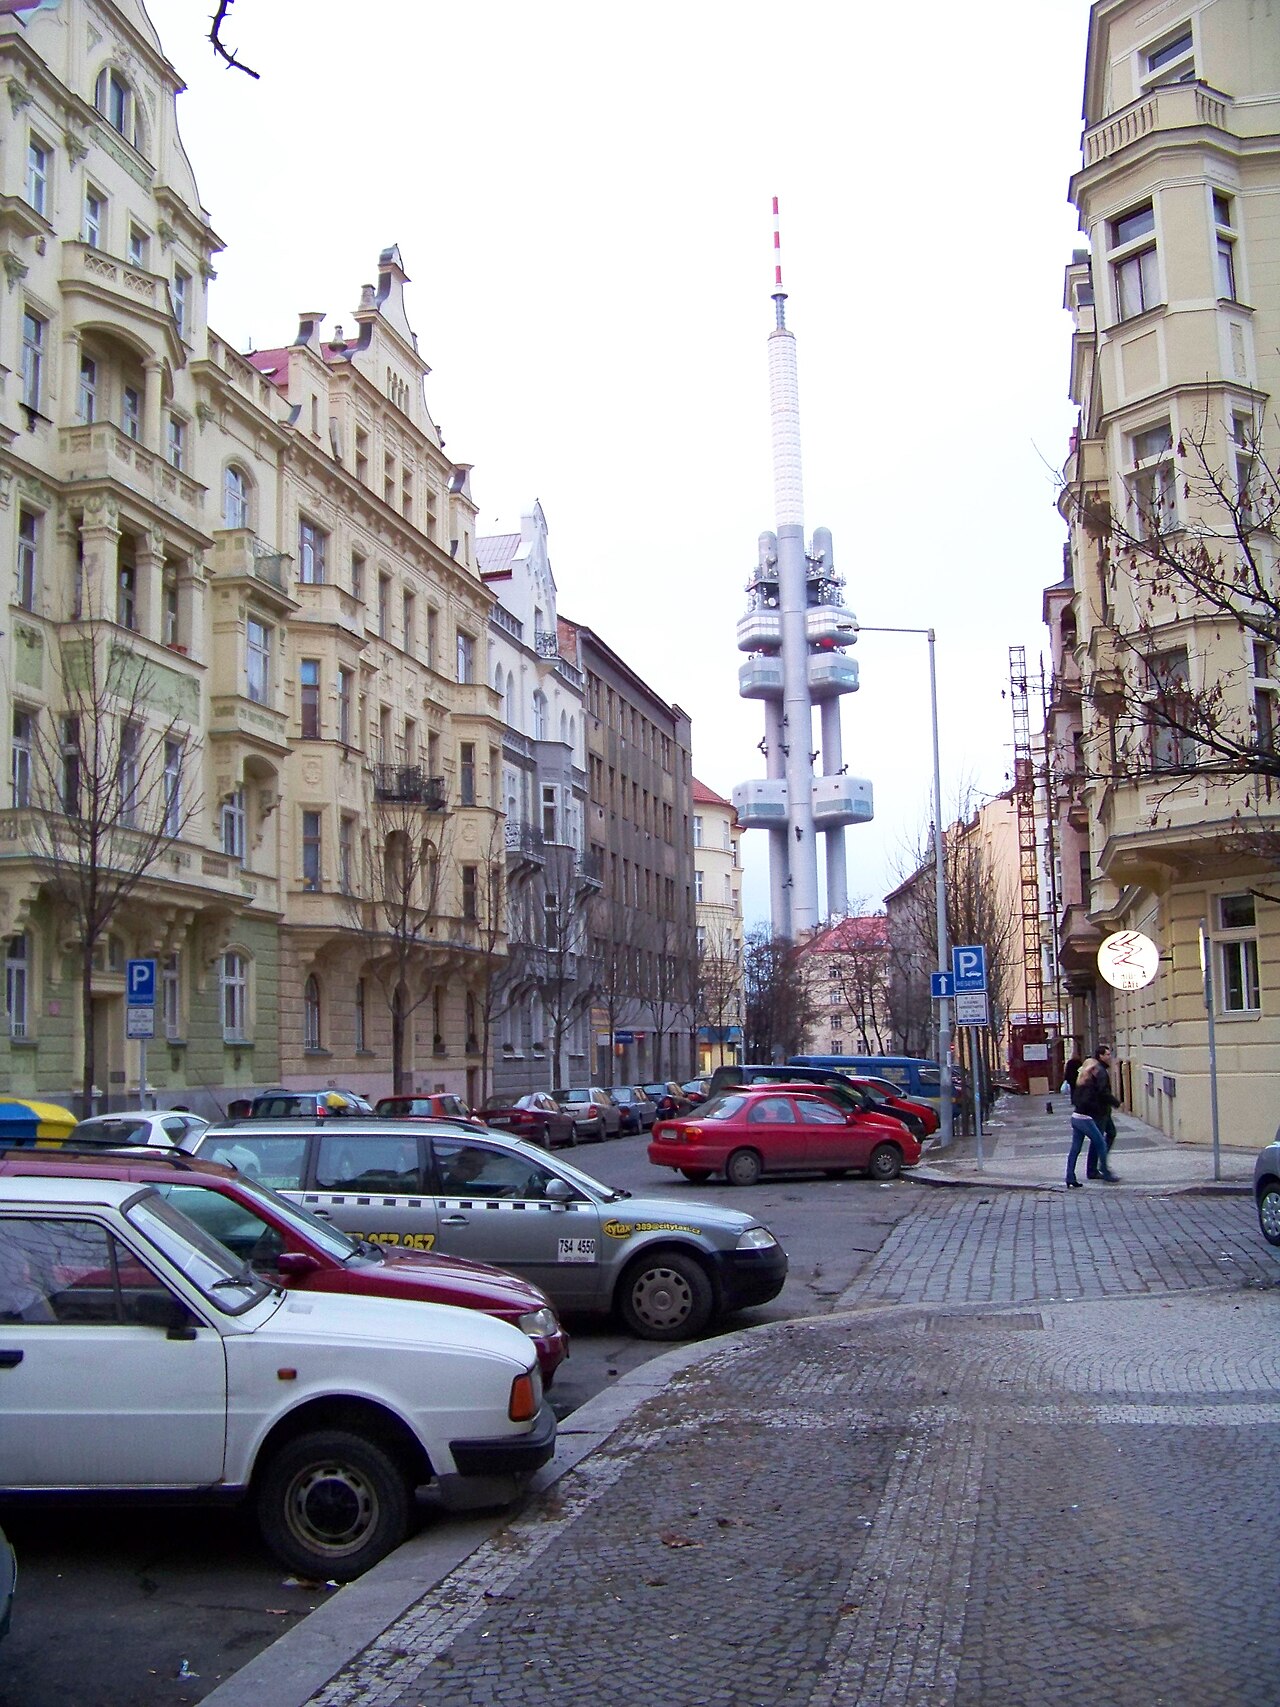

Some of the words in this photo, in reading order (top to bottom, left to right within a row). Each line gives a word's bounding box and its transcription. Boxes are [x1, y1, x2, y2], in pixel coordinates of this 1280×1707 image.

[133, 965, 150, 991] P
[959, 952, 978, 978] P
[560, 1239, 573, 1253] 7S4
[577, 1239, 595, 1254] 4550
